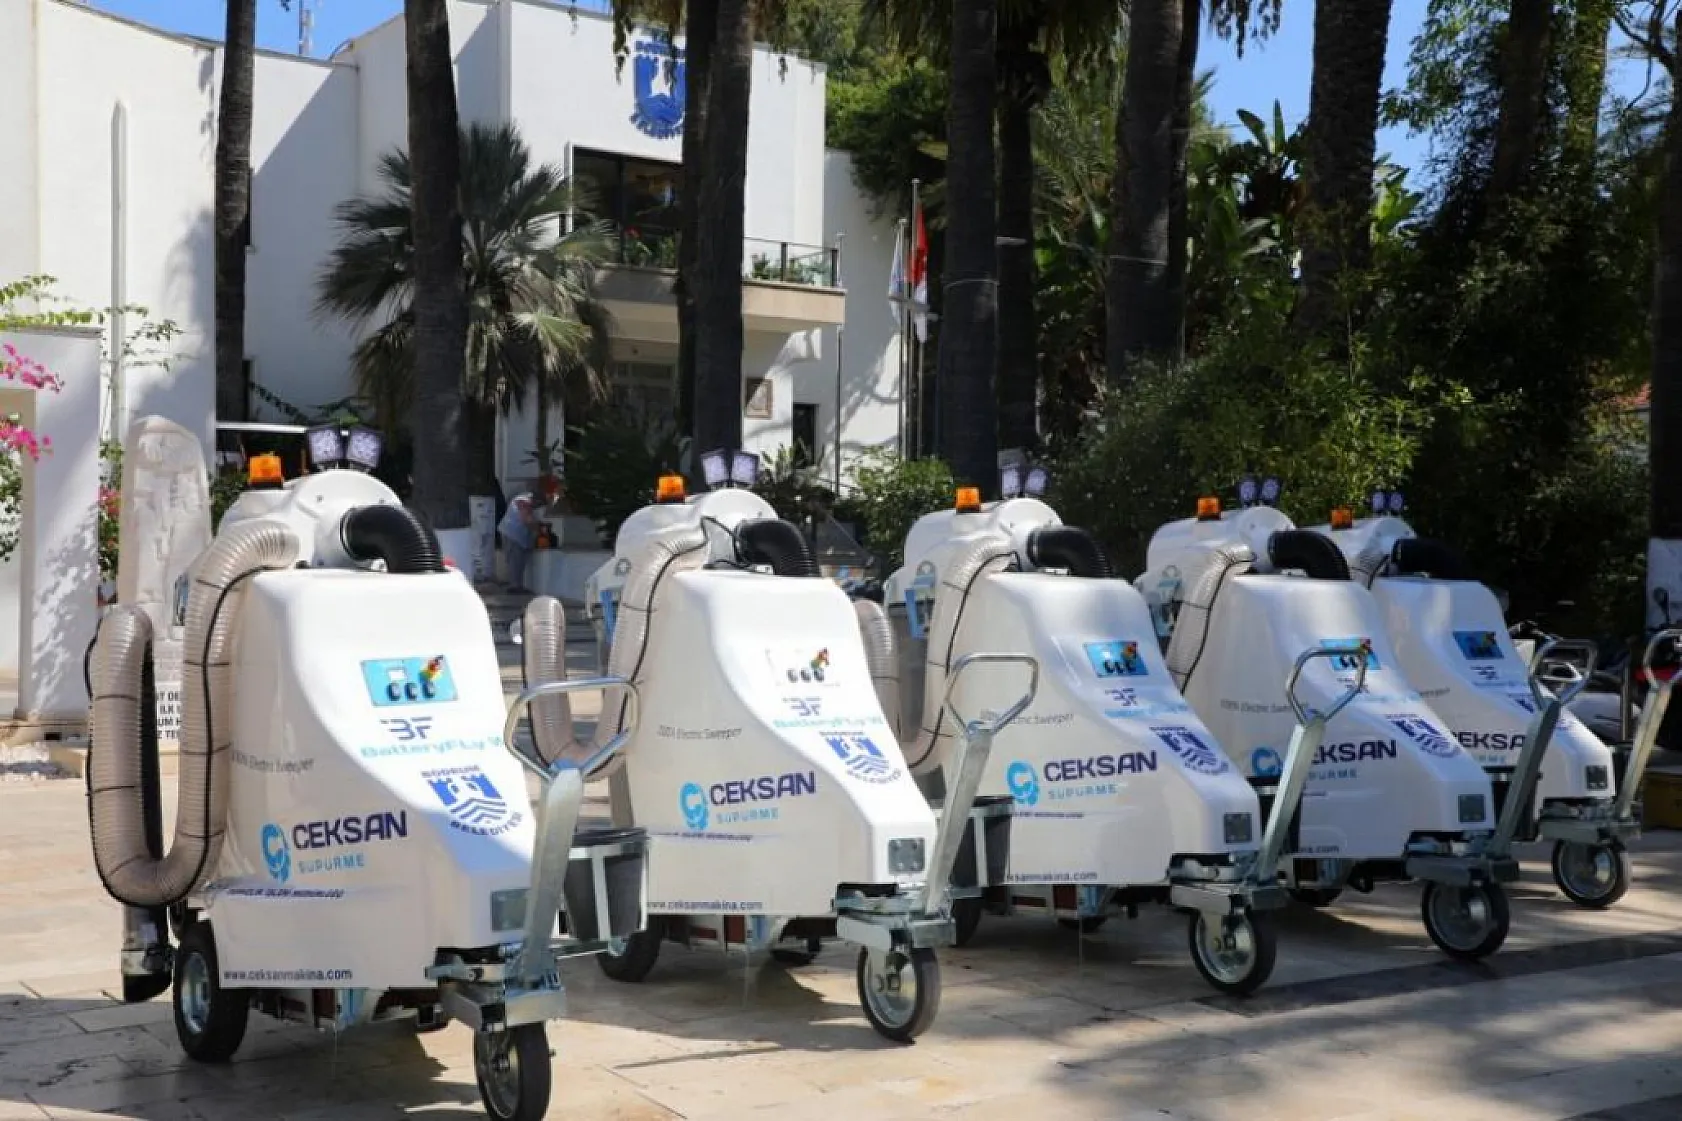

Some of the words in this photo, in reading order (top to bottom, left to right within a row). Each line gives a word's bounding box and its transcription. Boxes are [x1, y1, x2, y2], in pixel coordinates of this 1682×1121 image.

[1043, 749, 1158, 782] CEKSAN
[710, 770, 816, 806] CEKSAN
[292, 808, 408, 850] CEKSAN
[223, 968, 353, 982] www.ceksanmakina.com
